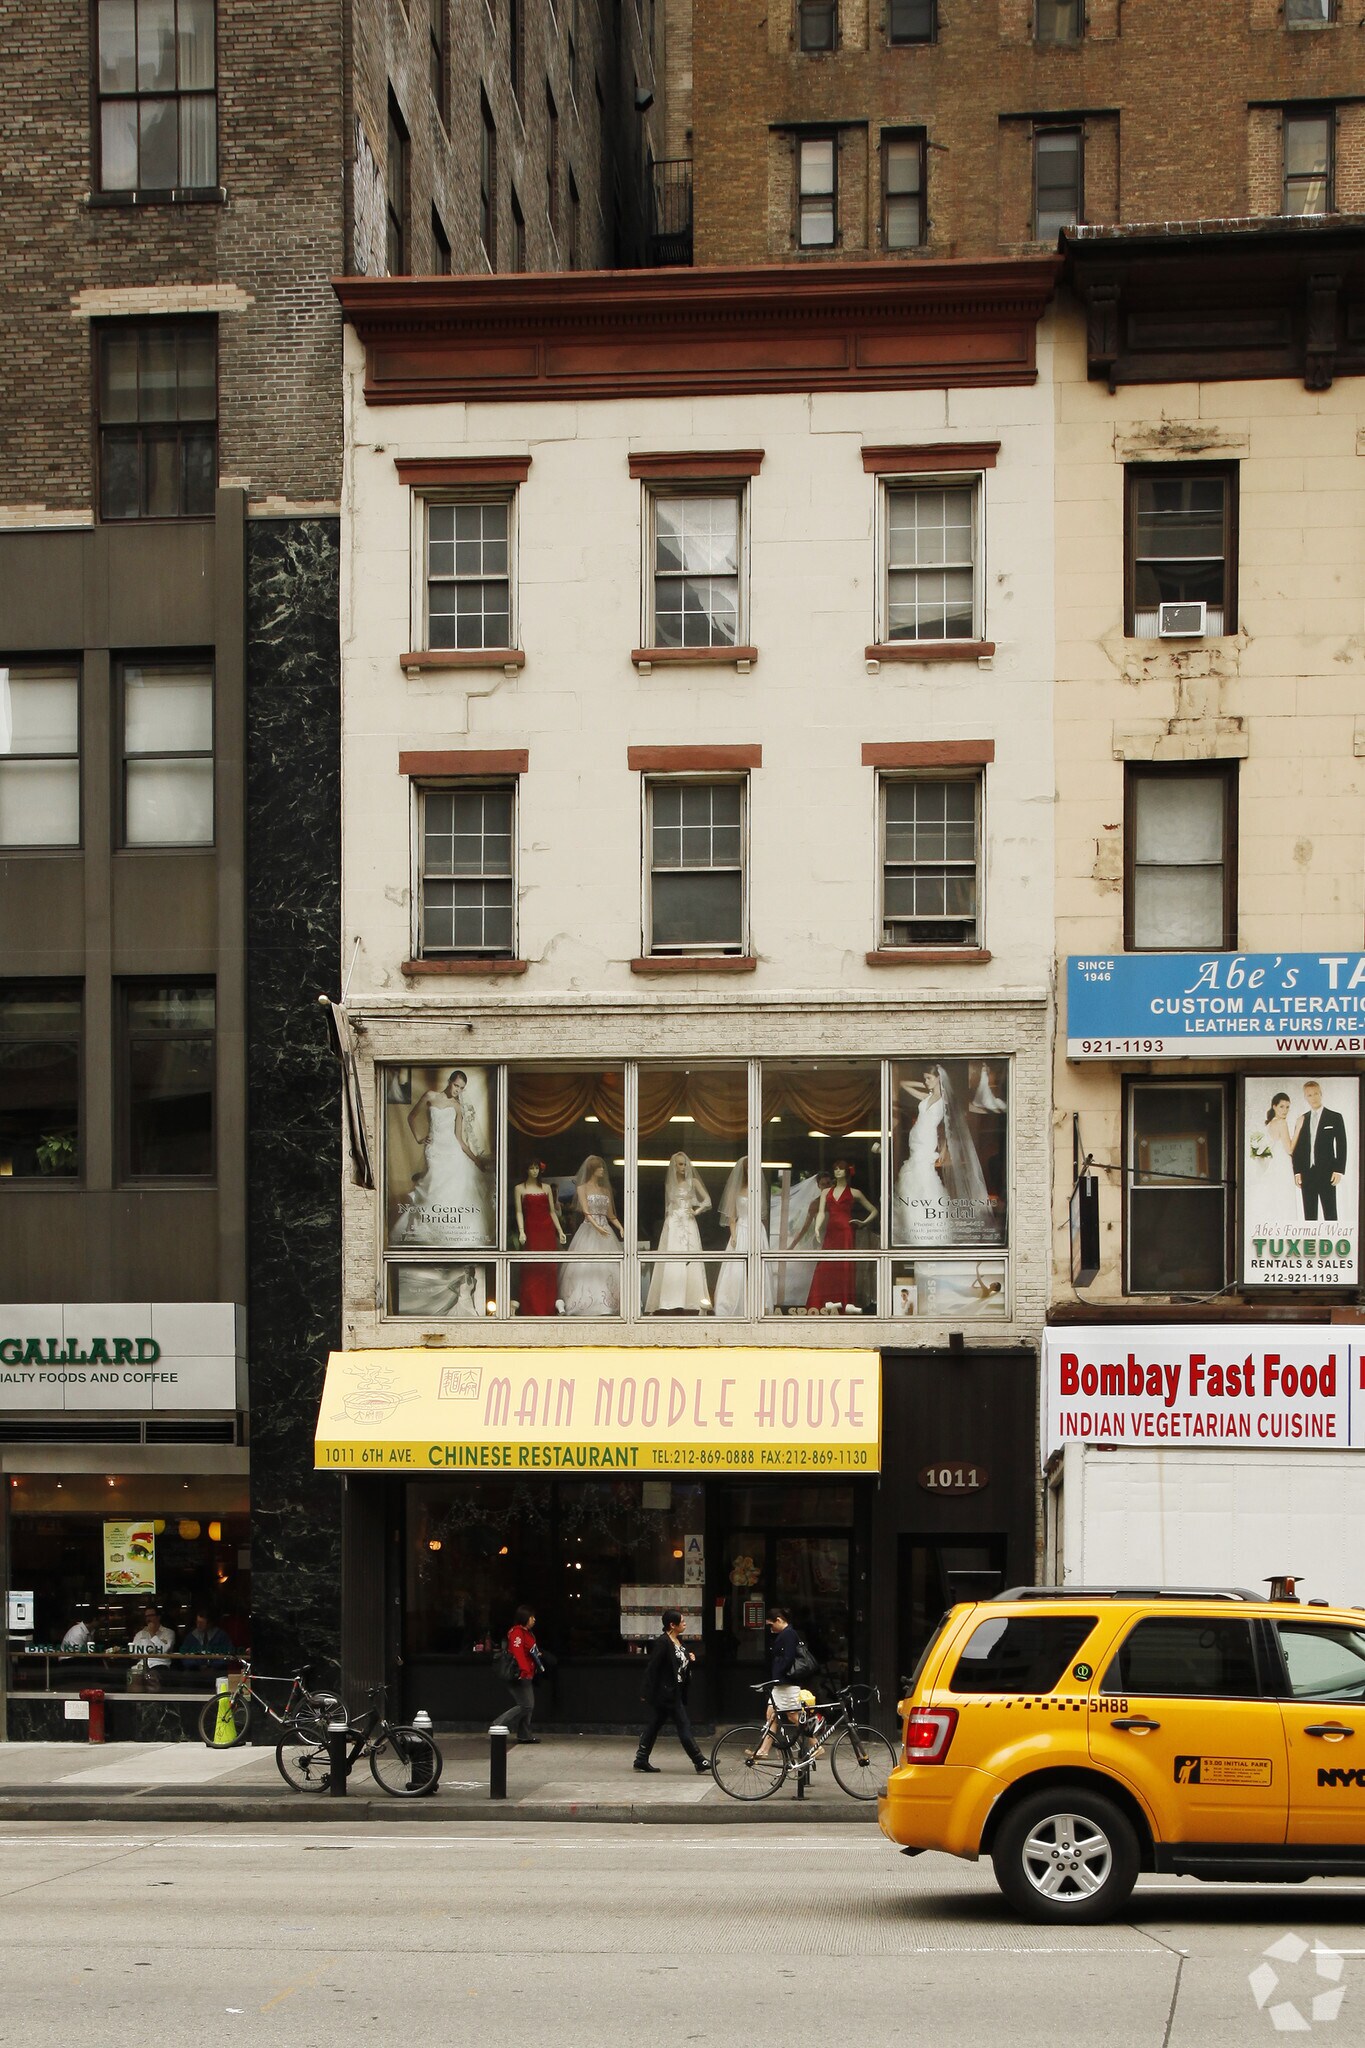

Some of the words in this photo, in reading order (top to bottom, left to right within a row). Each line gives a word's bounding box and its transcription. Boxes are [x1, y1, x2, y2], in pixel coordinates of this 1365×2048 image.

[1077, 961, 1115, 970] SINCE
[1083, 972, 1111, 981] 1946
[1184, 956, 1300, 994] Abe's
[1150, 997, 1244, 1014] CUSTOM
[1185, 1018, 1260, 1032] LEATHER
[1264, 1018, 1275, 1032] &
[1279, 1018, 1323, 1031] FURS
[1326, 1017, 1332, 1031] /
[1336, 1017, 1365, 1031] RE-
[1082, 1039, 1164, 1053] 921-1193
[1275, 1038, 1365, 1051] WWW.AB
[397, 1203, 427, 1214] New
[431, 1203, 481, 1214] Genesis
[898, 1196, 932, 1207] New
[938, 1196, 998, 1208] Genesis
[421, 1213, 462, 1224] Bridal
[925, 1207, 975, 1219] Bridal
[1251, 1222, 1281, 1238] Abe's
[1284, 1222, 1324, 1237] Formal
[1325, 1223, 1354, 1237] Wear
[1252, 1238, 1352, 1258] TUXEDO
[1251, 1260, 1303, 1269] RENTALS
[1306, 1260, 1313, 1269] &
[1317, 1260, 1354, 1269] SALES
[1264, 1273, 1339, 1283] 212-921-1193
[0, 1338, 161, 1366] GALLARD
[0, 1373, 35, 1383] IALTY
[39, 1372, 87, 1383] FOODS
[90, 1373, 119, 1383] AND
[123, 1372, 178, 1383] COFFEE
[1060, 1353, 1182, 1408] Bombay
[1189, 1353, 1256, 1397] Fast
[1263, 1353, 1336, 1397] Food
[483, 1377, 576, 1427] MAIN
[594, 1377, 737, 1428] NOODLE
[754, 1377, 865, 1429] HOUSE
[1060, 1412, 1125, 1437] INDIAN
[1131, 1412, 1251, 1438] VEGETARIAN
[1257, 1413, 1336, 1438] CUISINE
[325, 1448, 354, 1462] 1011
[361, 1448, 384, 1462] 6TH
[389, 1449, 416, 1463] AVE.
[428, 1445, 512, 1467] CHINESE
[519, 1446, 639, 1467] RESTAURANT
[652, 1449, 755, 1464] TEL:212-869-0888
[761, 1450, 868, 1465] FAX:212-869-1130
[926, 1469, 980, 1487] 1011
[687, 1537, 701, 1552] A
[1089, 1698, 1129, 1713] 5H88
